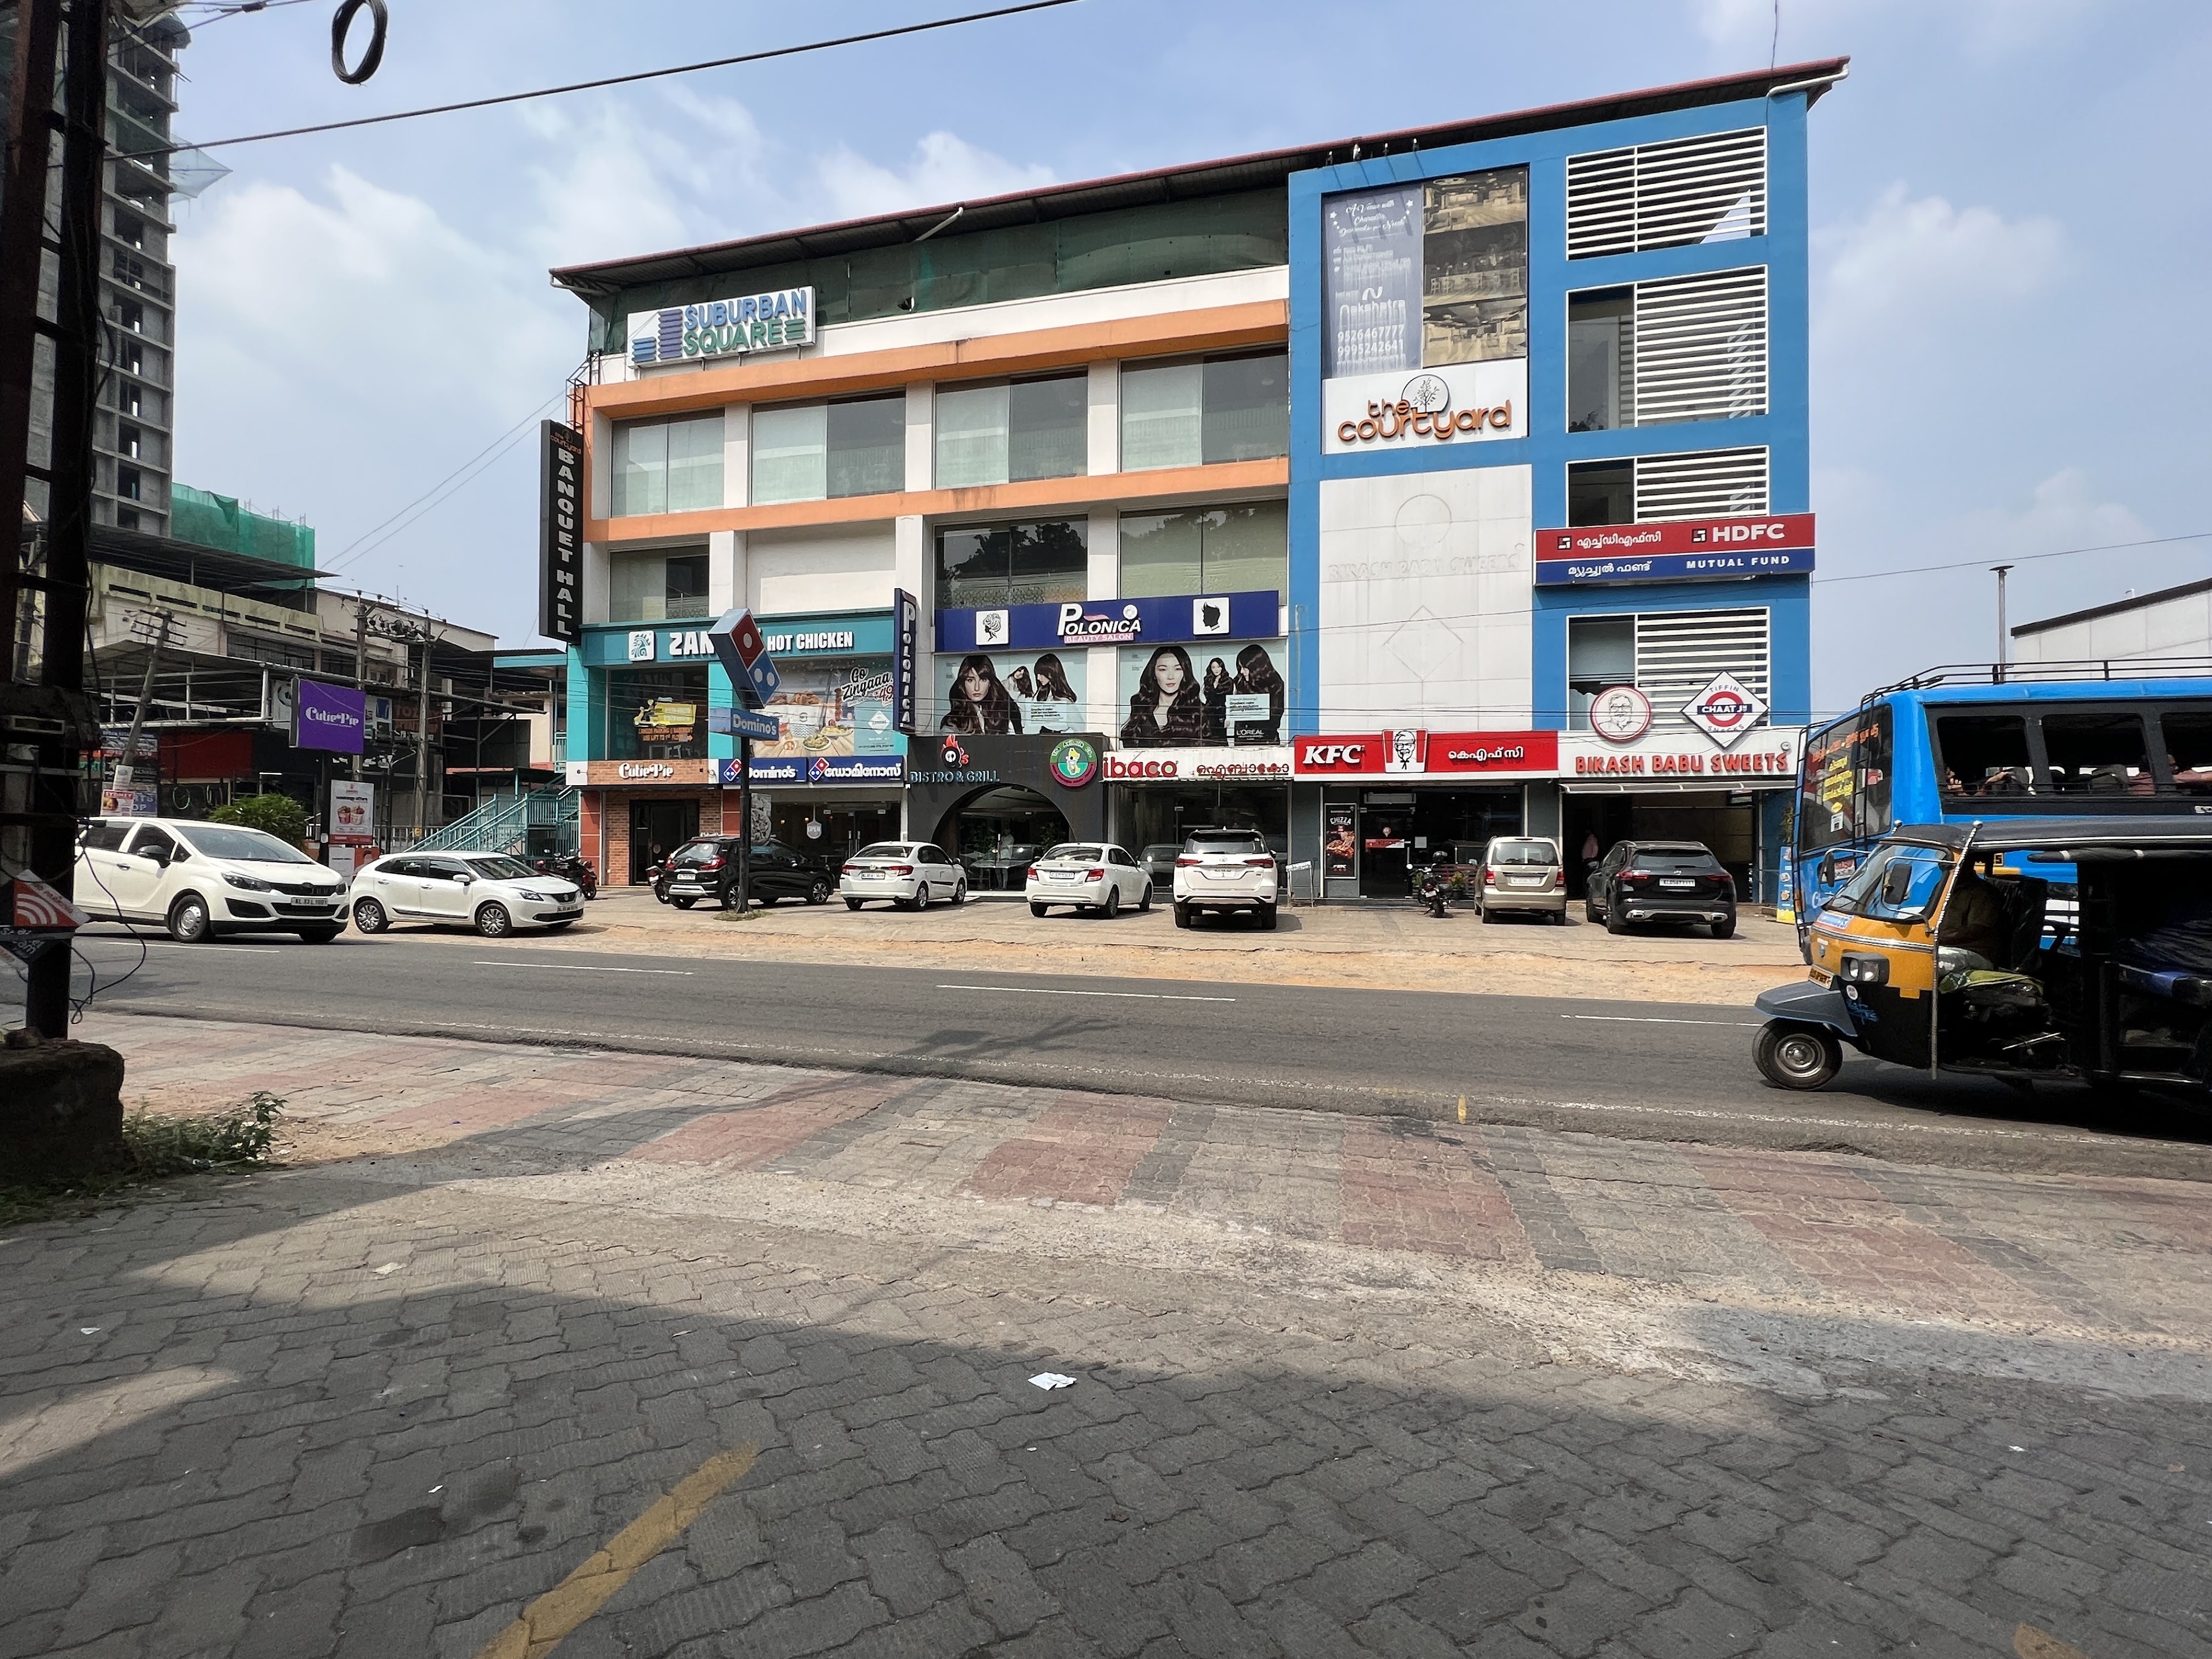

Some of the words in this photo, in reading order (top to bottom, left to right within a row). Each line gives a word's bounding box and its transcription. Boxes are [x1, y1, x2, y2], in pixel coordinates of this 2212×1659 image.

[684, 289, 806, 330] SUBURBAN
[683, 317, 783, 355] SQUARE
[1368, 399, 1410, 418] the
[1338, 399, 1511, 442] courtyard
[557, 448, 574, 563] BANQUET
[1713, 523, 1785, 542] HDFC
[1687, 558, 1744, 569] MUTUAL
[1751, 555, 1790, 566] FUND
[556, 570, 574, 635] HALL
[1057, 603, 1141, 635] POLONICA
[767, 634, 794, 652] HOT
[796, 631, 853, 649] CHICKEN
[902, 601, 916, 722] POLONICA
[851, 667, 868, 683] Go
[1709, 684, 1740, 692] TIFFIN
[1702, 705, 1736, 713] CHAAT
[733, 713, 777, 736] Domino's
[1707, 724, 1745, 732] SNACKS
[1302, 744, 1362, 764] KFC
[1575, 755, 1645, 773] BIKASH
[1652, 754, 1703, 772] BABU
[1711, 752, 1789, 772] SWEETS
[910, 771, 954, 783] BISTRO
[955, 771, 964, 783] &
[965, 770, 1000, 782] GRILL
[1103, 757, 1177, 778] ibaco
[1330, 817, 1351, 825] CHIZZA
